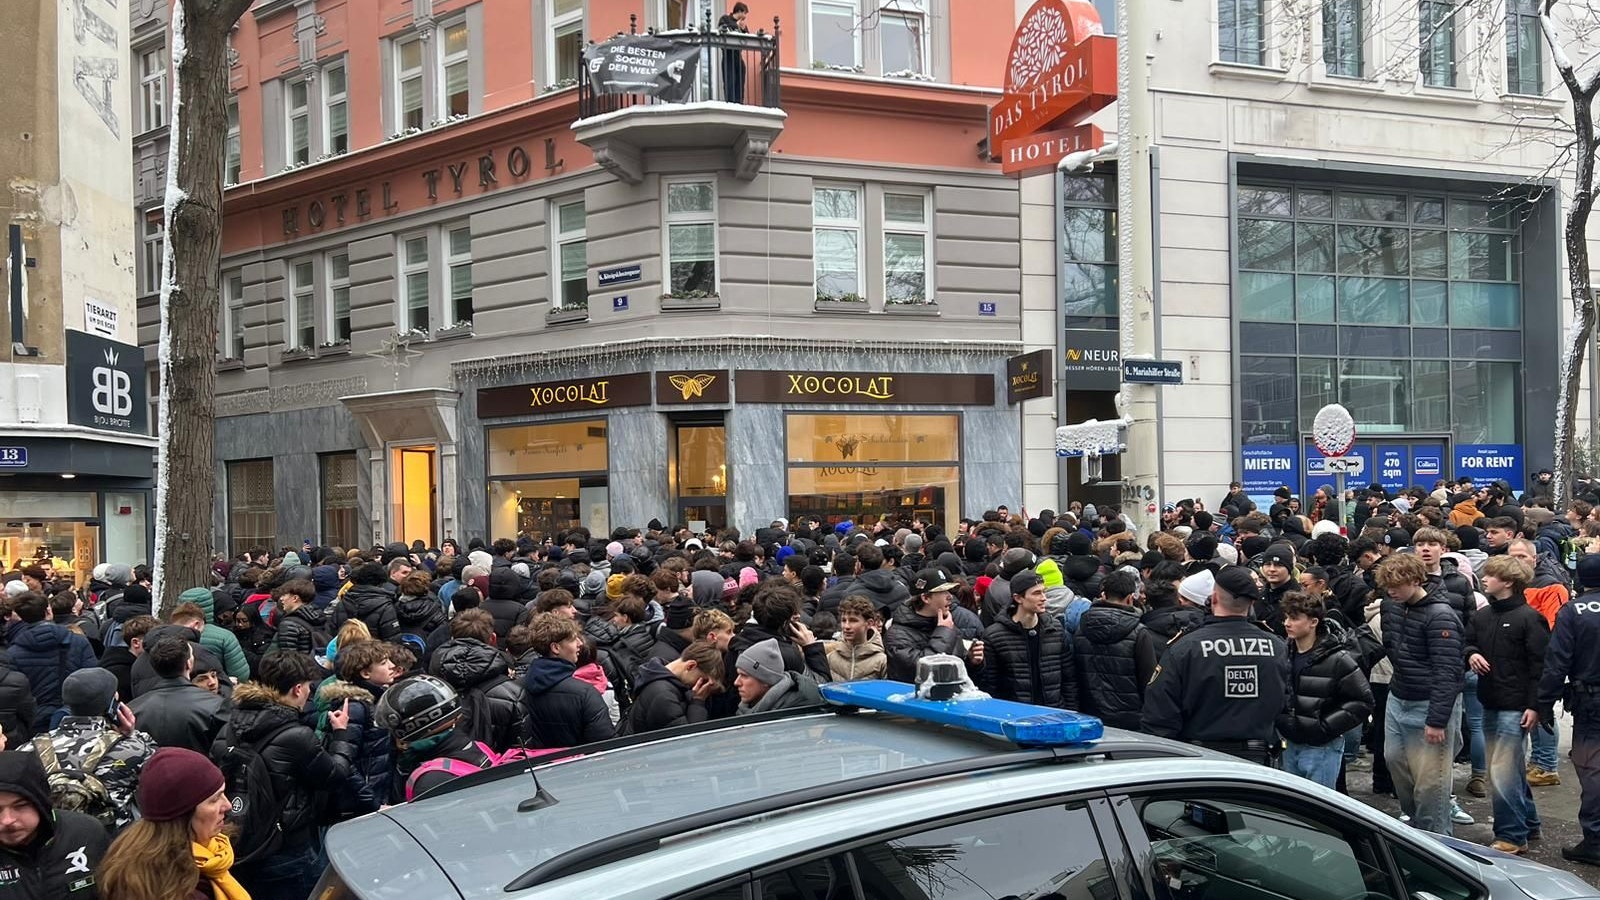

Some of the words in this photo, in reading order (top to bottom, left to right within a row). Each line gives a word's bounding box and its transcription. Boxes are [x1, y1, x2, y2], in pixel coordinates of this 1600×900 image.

[610, 45, 626, 53] DIE
[627, 46, 666, 60] BESTEN
[615, 54, 656, 67] SOCKEN
[608, 63, 628, 73] DER
[995, 100, 1022, 135] DAS
[1029, 57, 1088, 111] TYROL
[1010, 134, 1085, 163] HOTEL
[281, 182, 399, 235] HOTEL
[421, 137, 564, 200] TYROL
[617, 297, 623, 306] 9
[983, 303, 993, 312] 15
[86, 302, 117, 321] TIERARZT
[1084, 349, 1119, 361] NEUR
[1012, 371, 1039, 387] XOCOLAT
[788, 374, 895, 399] XOCOLAT
[530, 381, 610, 407] XOCOLAT
[2, 448, 19, 460] 13
[1244, 458, 1291, 470] MIETEN
[1384, 458, 1400, 467] 470
[1461, 456, 1484, 468] FOR
[1485, 456, 1514, 468] RENT
[1383, 469, 1402, 479] sqm
[1574, 601, 1600, 615] PO
[1200, 638, 1275, 657] POLIZEI
[1228, 670, 1255, 680] DELTA
[1229, 682, 1255, 693] 700
